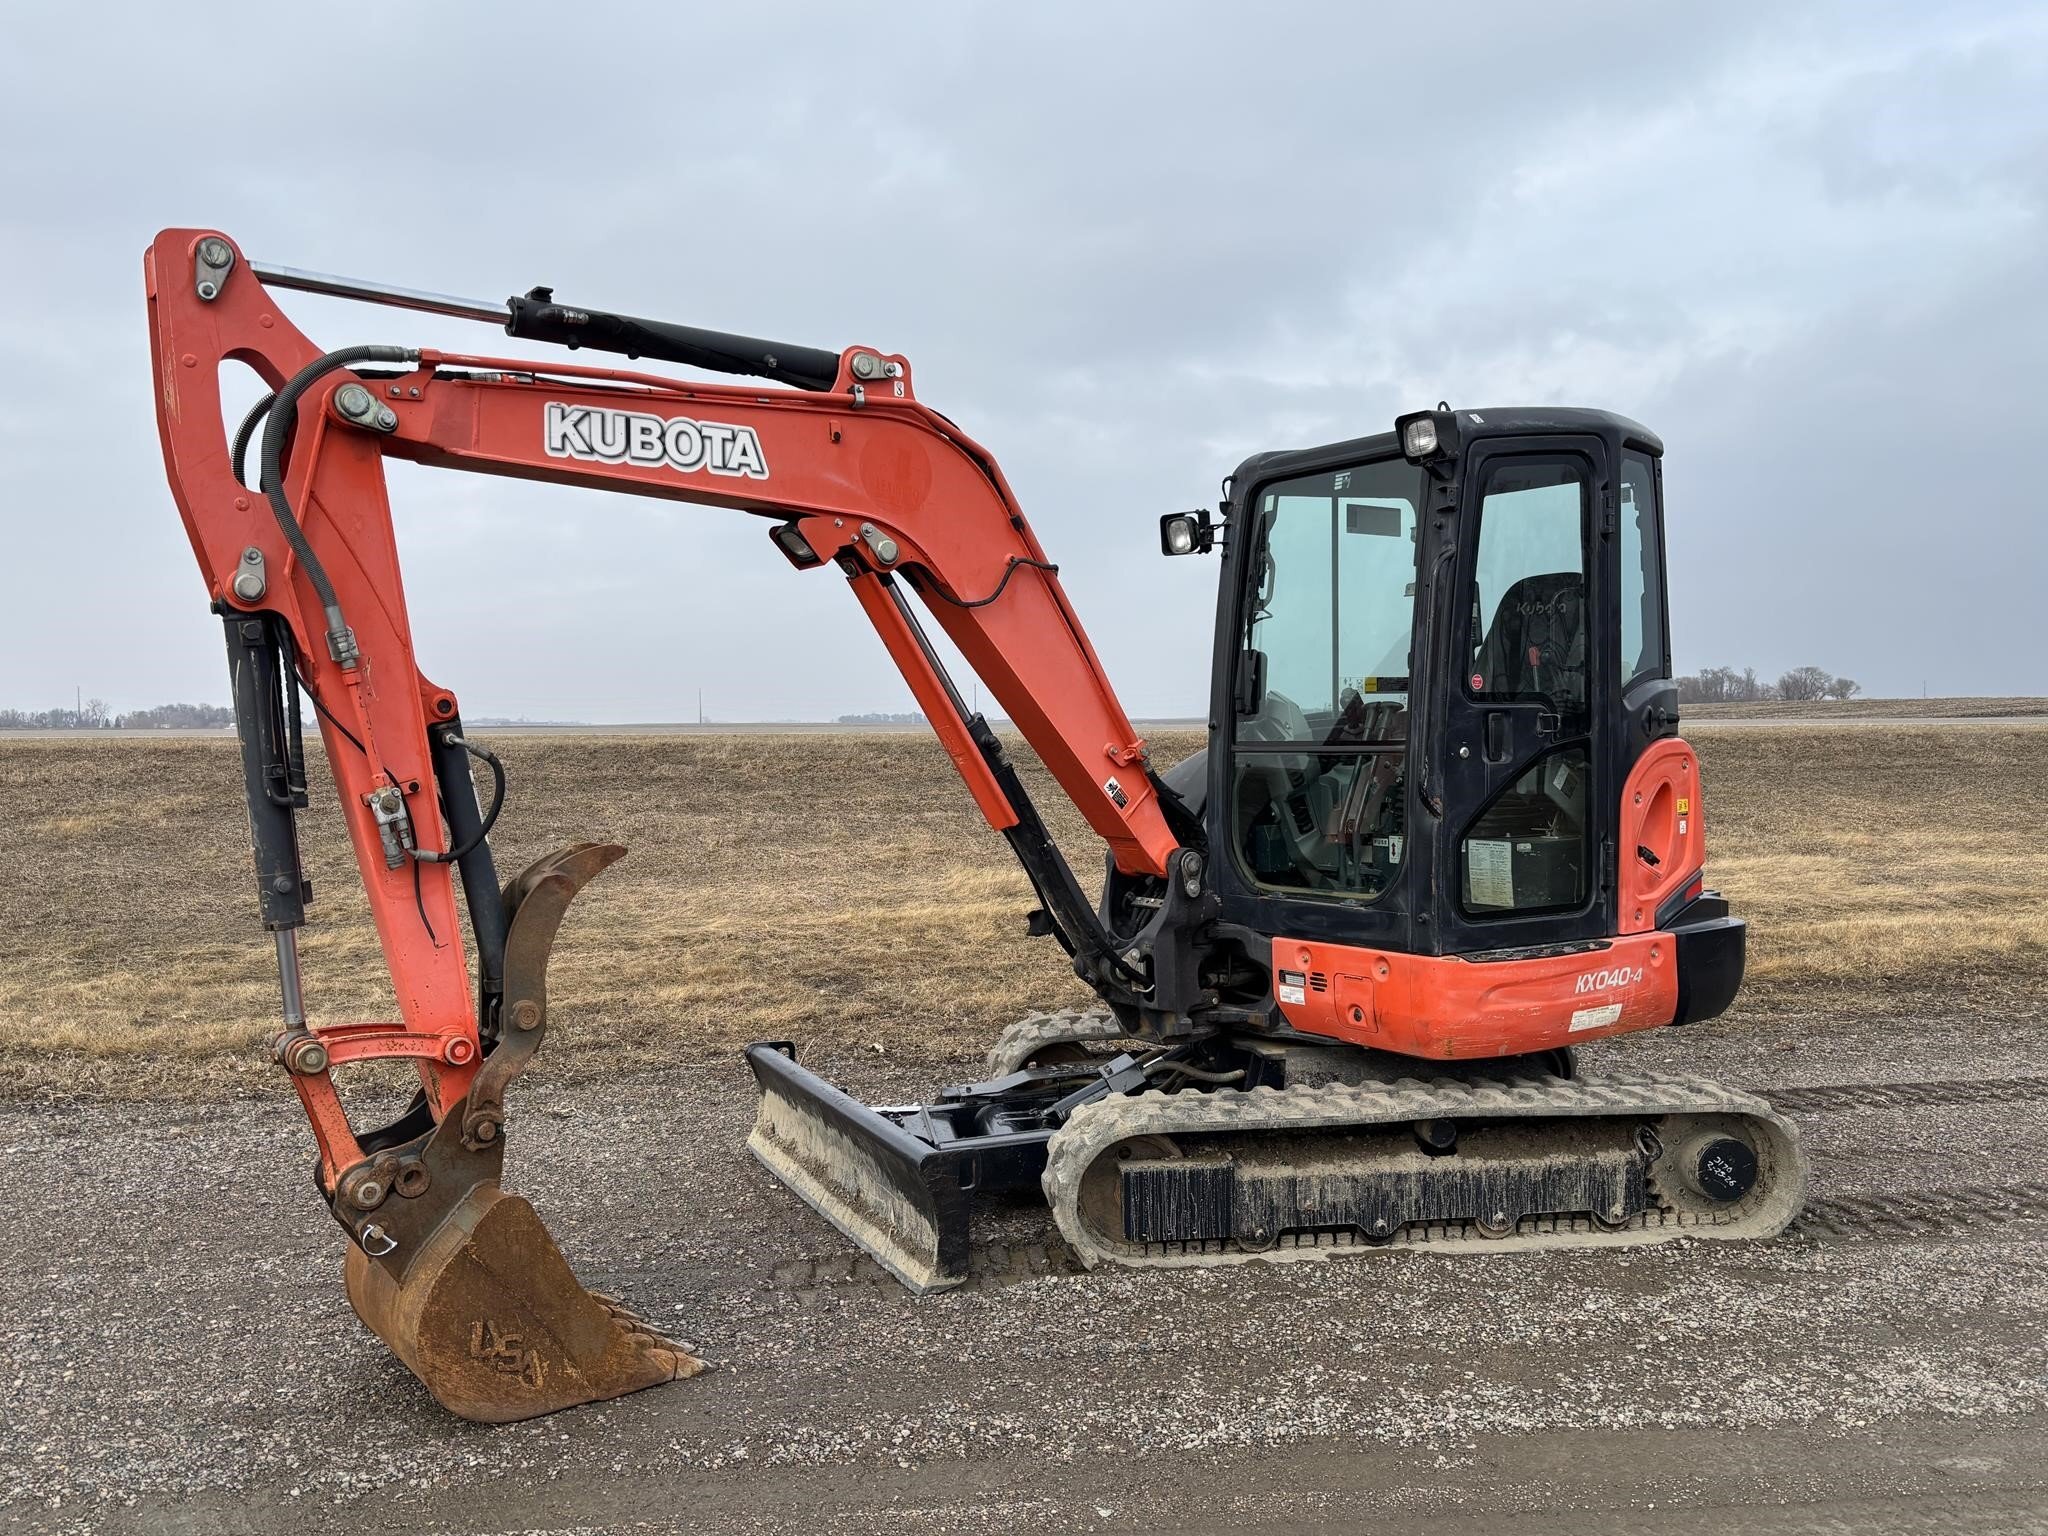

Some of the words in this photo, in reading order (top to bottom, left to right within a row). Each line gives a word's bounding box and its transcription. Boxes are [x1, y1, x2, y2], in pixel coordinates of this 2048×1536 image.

[547, 403, 767, 477] KUBOTA
[1516, 601, 1567, 616] Kuboa
[1574, 966, 1643, 994] KX040-4
